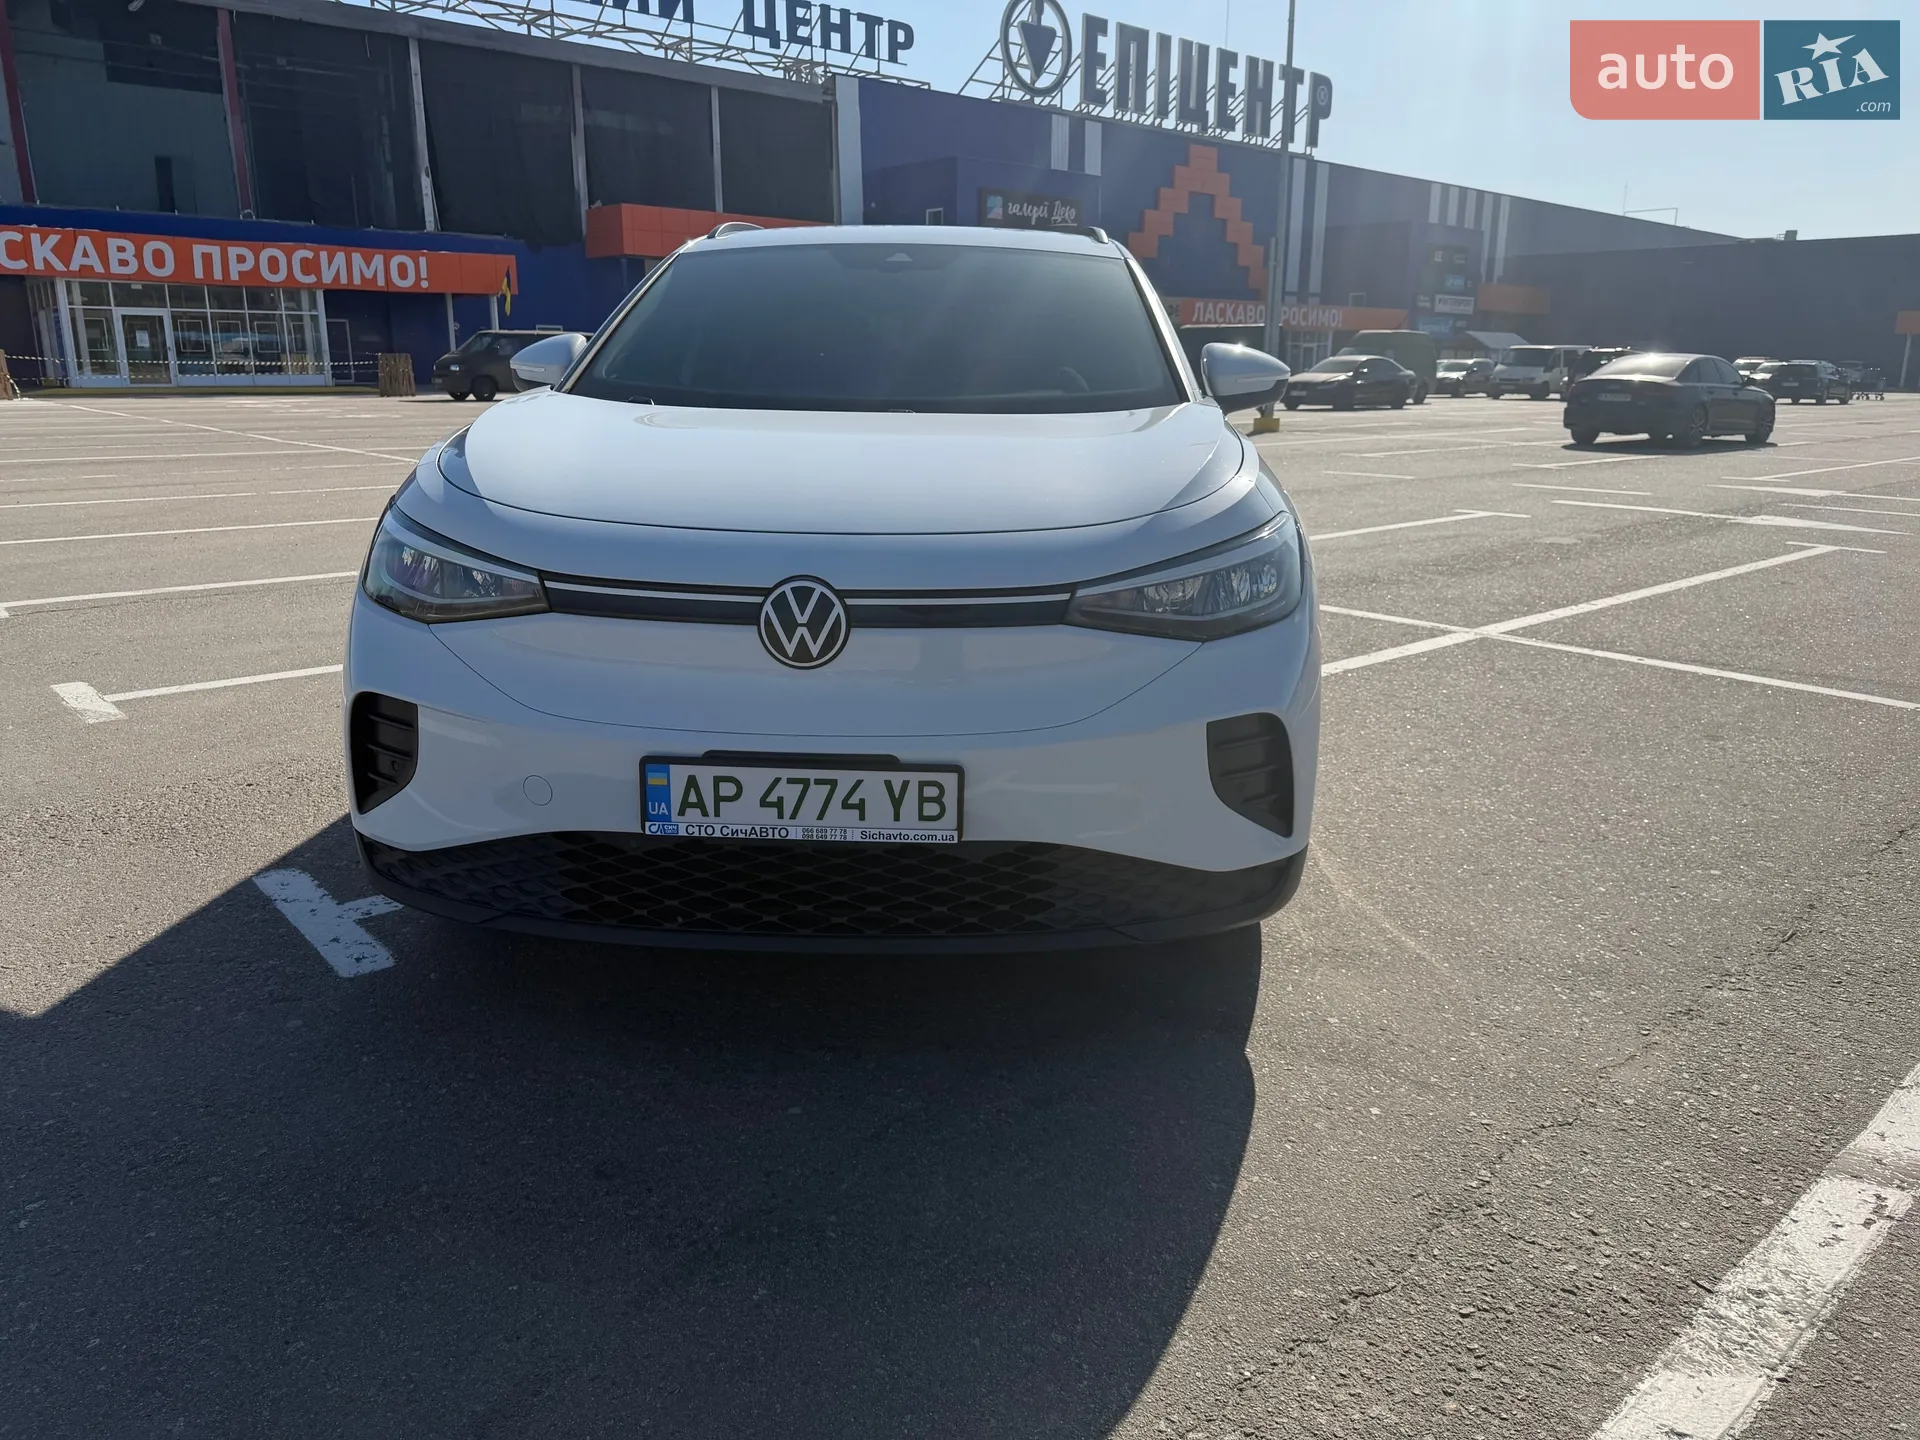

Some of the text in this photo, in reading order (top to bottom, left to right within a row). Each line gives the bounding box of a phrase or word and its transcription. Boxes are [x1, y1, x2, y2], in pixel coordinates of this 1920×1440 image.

[743, 0, 914, 63] ЦЕНТР
[192, 243, 429, 289] ПРОСИМО!
[1192, 302, 1266, 323] ЛАСКАВО
[1280, 306, 1343, 328] РОСИМО!
[648, 801, 669, 815] UA
[677, 774, 946, 822] AP 4774 YB
[685, 824, 789, 839] СТО СичАВТО
[860, 830, 955, 842] Sichavto.com.ua
